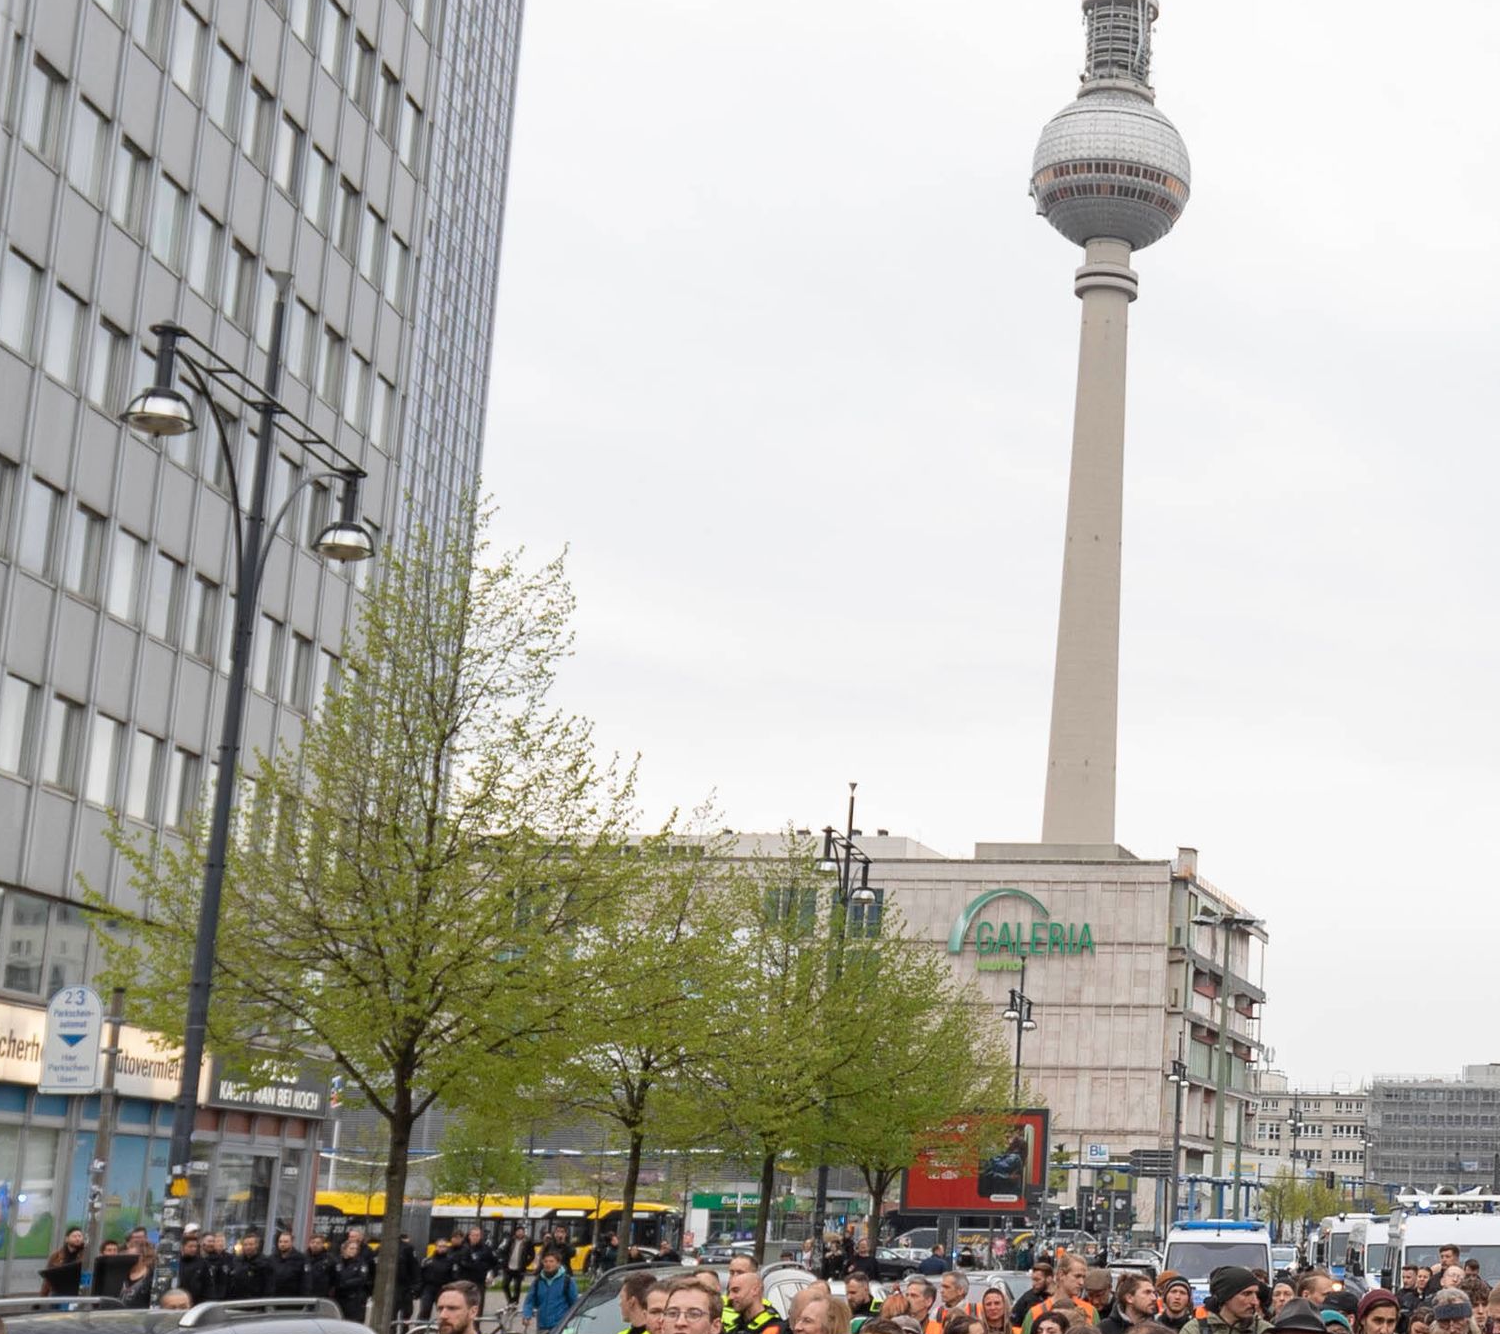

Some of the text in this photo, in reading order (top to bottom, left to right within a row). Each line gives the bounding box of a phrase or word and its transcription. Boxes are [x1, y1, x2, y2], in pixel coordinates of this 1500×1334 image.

[976, 921, 1095, 955] GALERIA
[276, 1088, 293, 1107] BEI
[293, 1090, 319, 1111] KOCH
